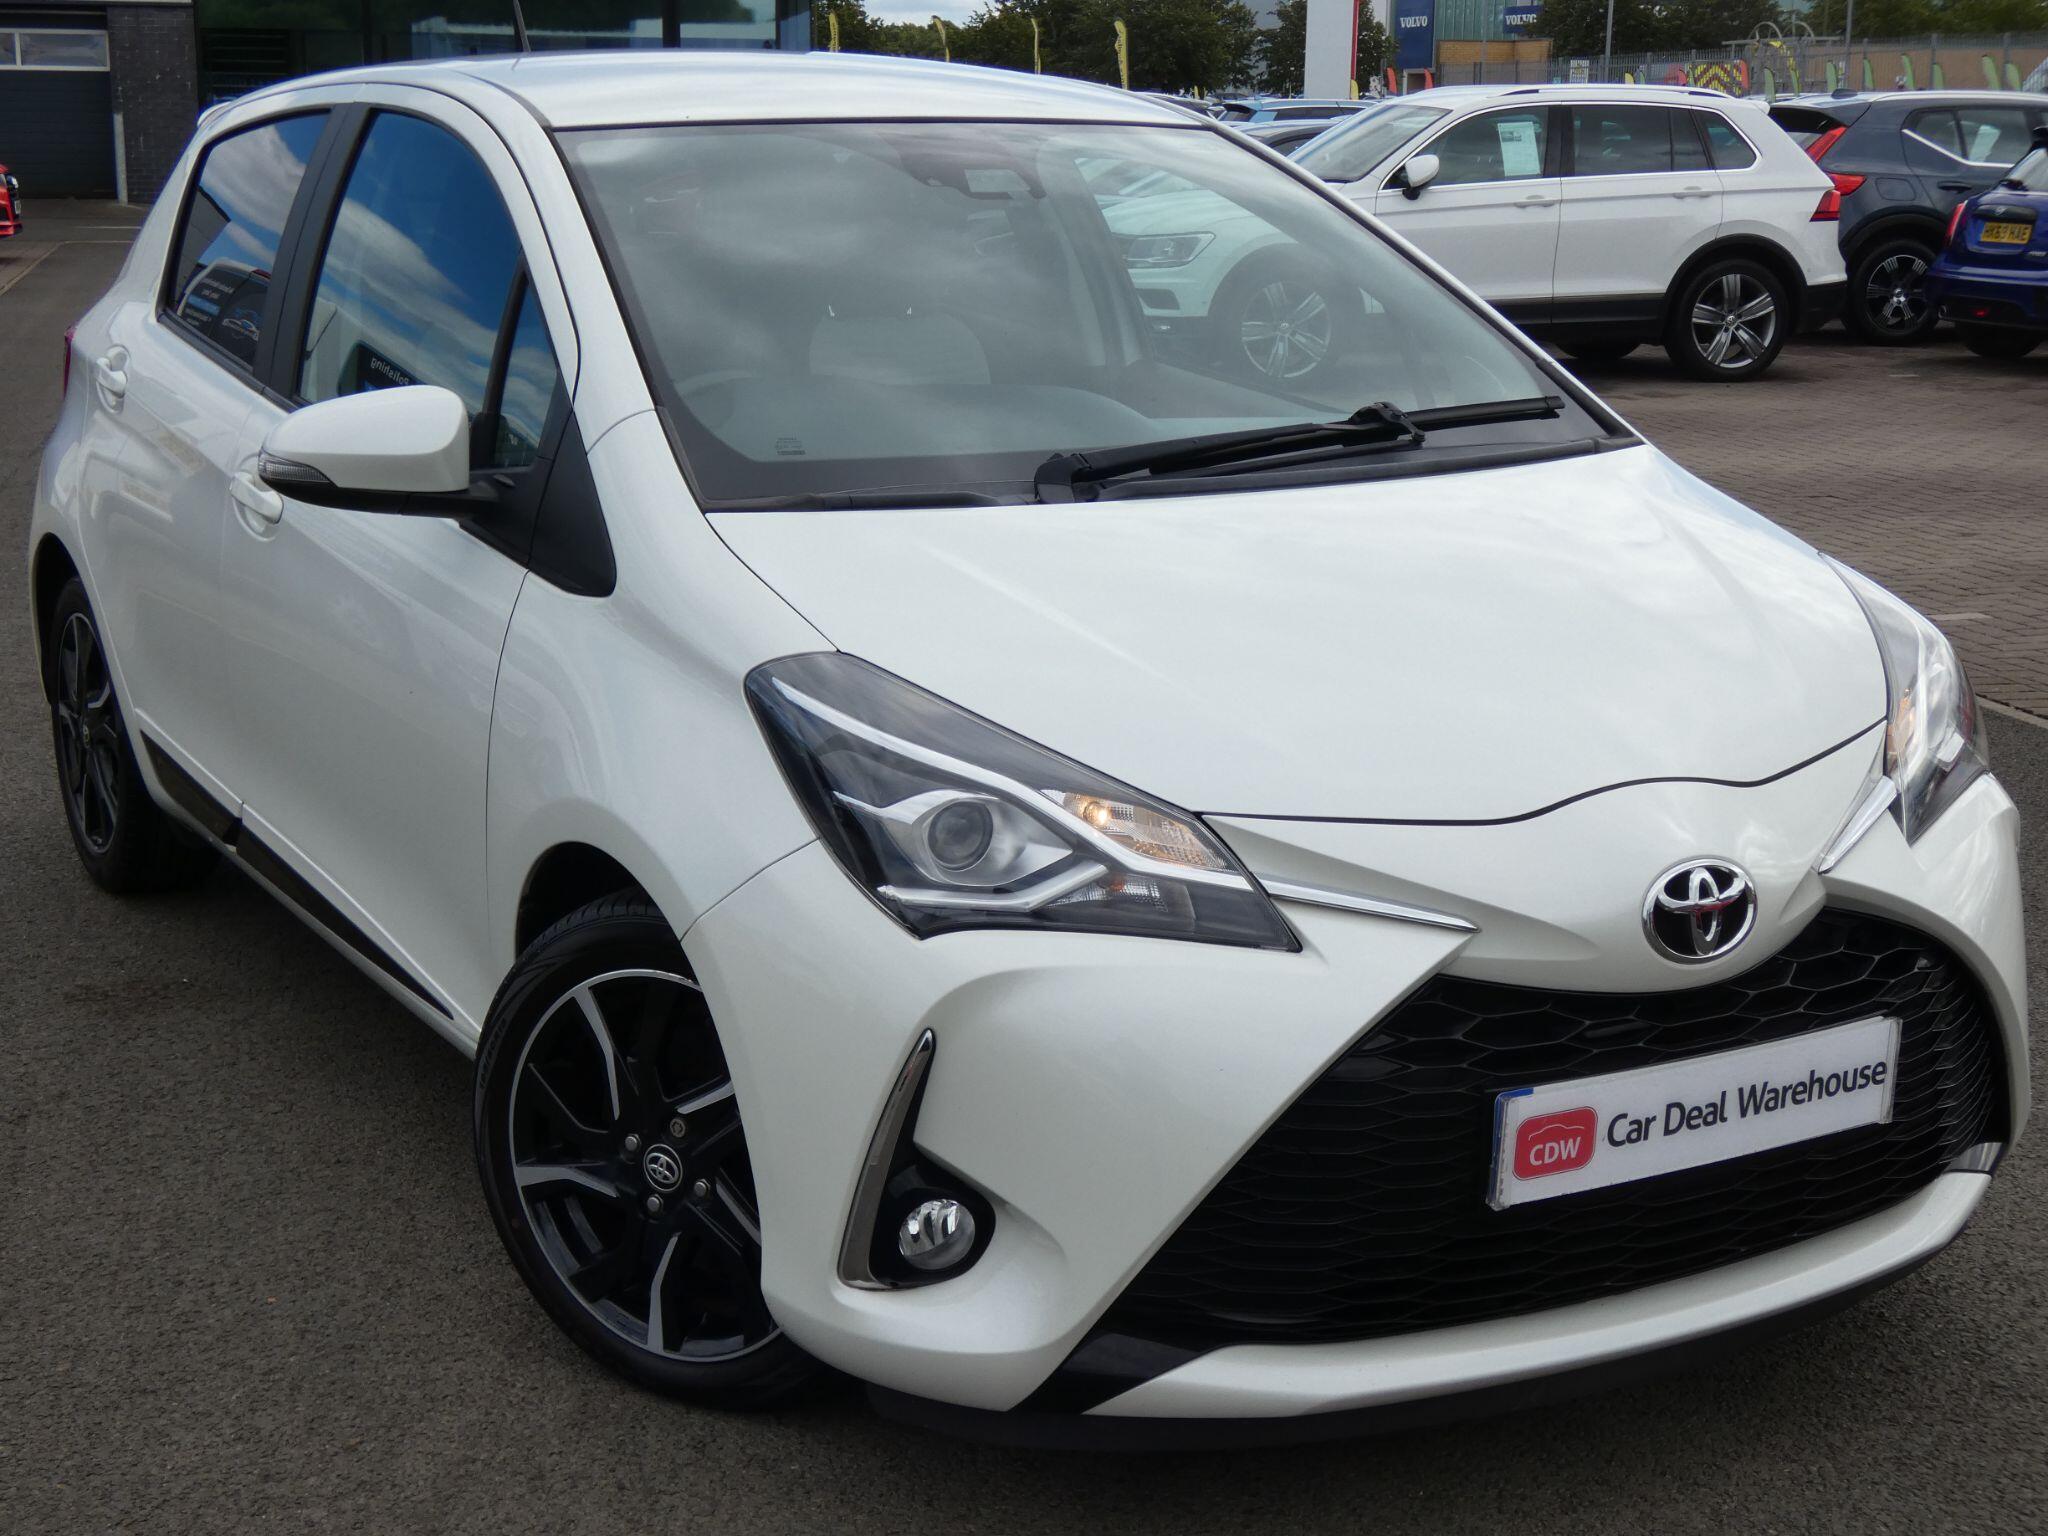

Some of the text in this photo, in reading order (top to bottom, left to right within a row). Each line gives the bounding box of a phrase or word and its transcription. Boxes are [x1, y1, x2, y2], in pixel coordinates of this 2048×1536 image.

[1400, 16, 1427, 28] VOLVO
[1607, 1061, 1887, 1147] Car Deal Warehouse
[1529, 1137, 1581, 1166] CDW
